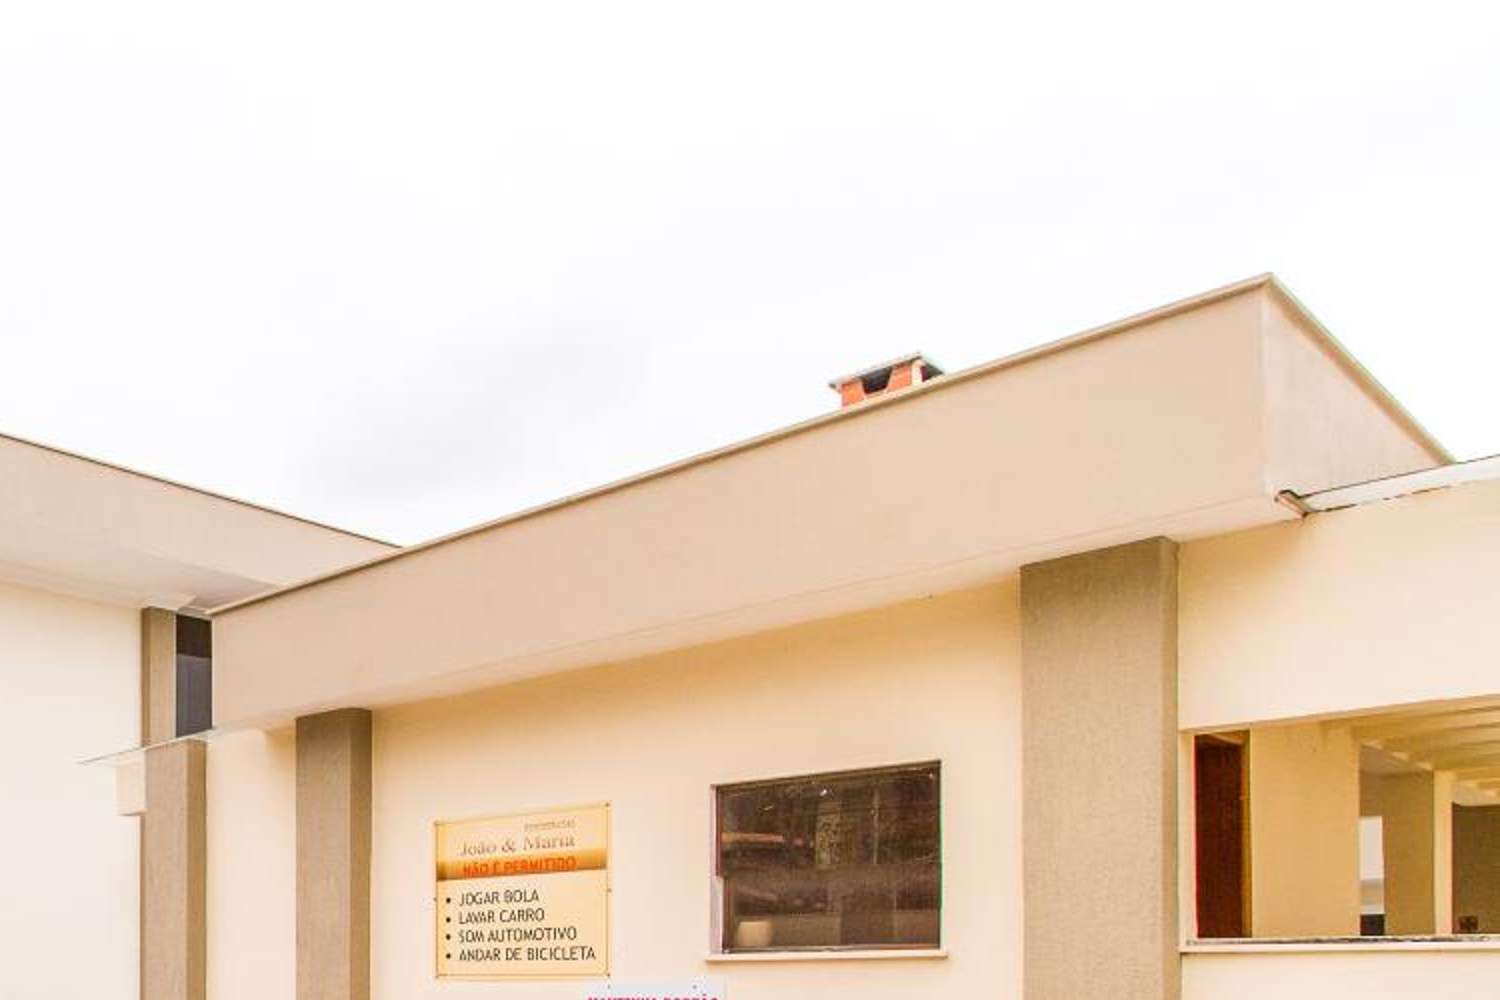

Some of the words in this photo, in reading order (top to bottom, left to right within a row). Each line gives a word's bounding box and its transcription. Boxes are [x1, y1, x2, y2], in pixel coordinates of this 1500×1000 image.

[501, 839, 516, 854] &
[463, 861, 488, 876] NÃO
[503, 856, 576, 872] PERMITIDO
[459, 892, 500, 907] JOGAR
[504, 889, 540, 903] BOLA
[458, 910, 495, 925] LAVAR
[500, 908, 545, 923] CARRO
[458, 929, 484, 943] SOM
[487, 926, 577, 942] AUTOMOTIVO
[459, 948, 500, 961] ANDAR
[505, 948, 522, 960] DE
[527, 946, 596, 961] BICICLETA
